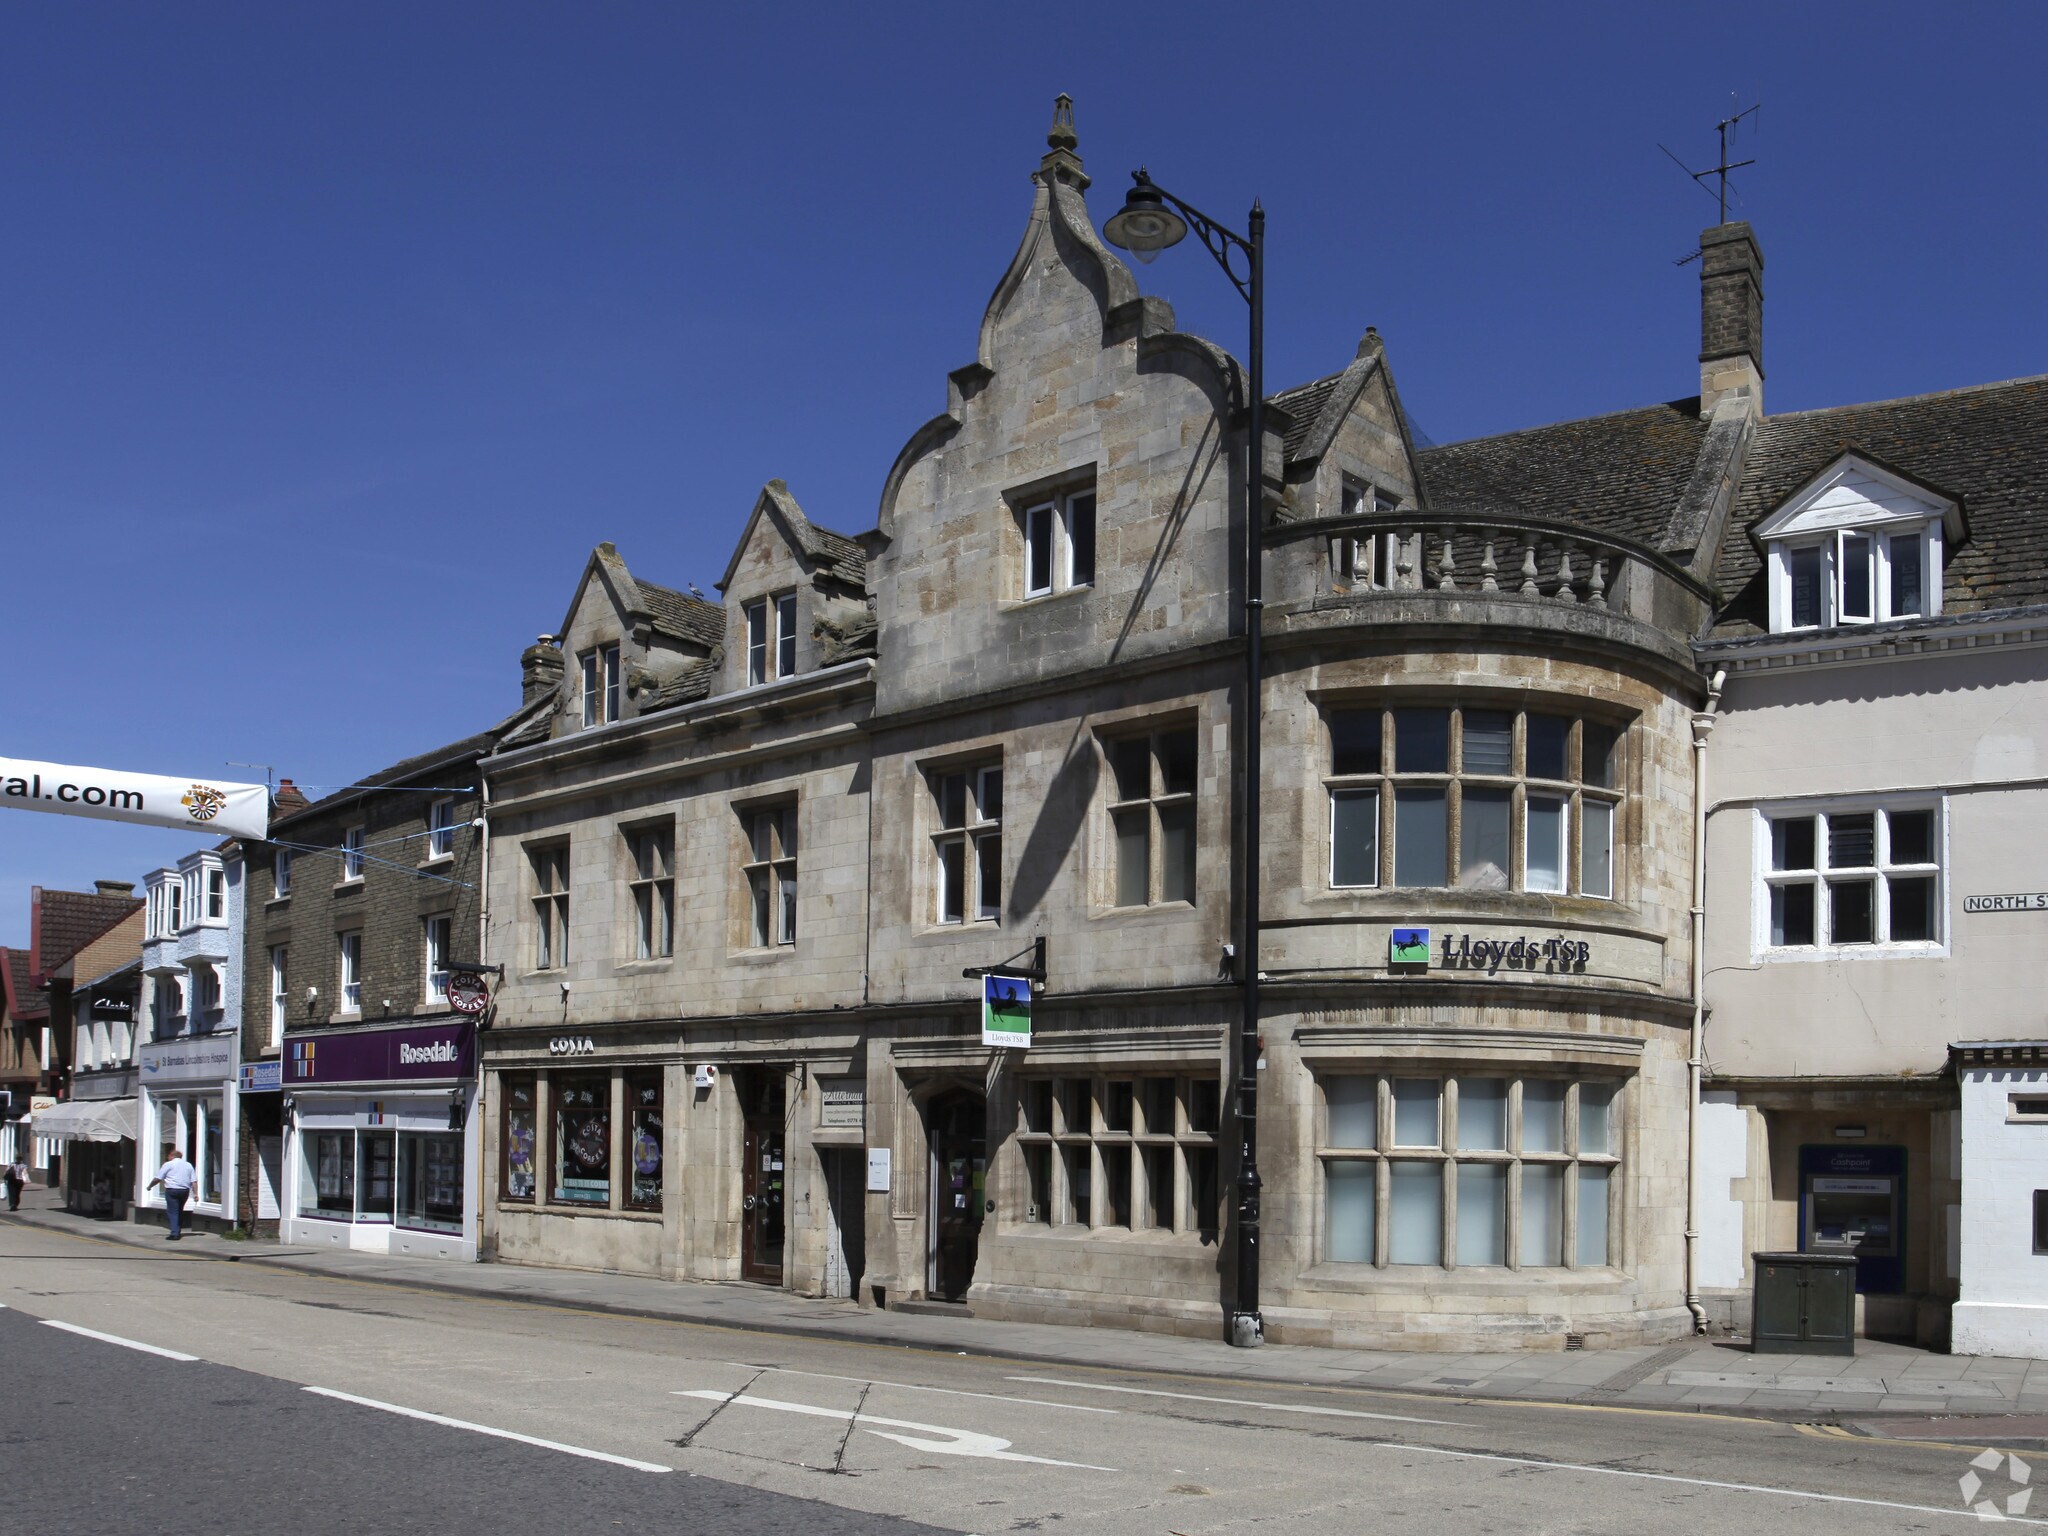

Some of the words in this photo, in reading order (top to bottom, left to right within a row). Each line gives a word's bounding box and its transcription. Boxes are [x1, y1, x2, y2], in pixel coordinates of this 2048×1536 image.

[1969, 895, 2027, 909] NORTH
[2036, 895, 2048, 907] S
[1444, 934, 1540, 965] Lloyds
[1547, 938, 1590, 962] TSB
[455, 977, 480, 988] COSTA
[453, 995, 483, 1010] COFFEE
[550, 1036, 594, 1053] COSTA
[992, 1033, 1011, 1044] Lloyds
[1013, 1035, 1024, 1043] TSB
[400, 1040, 458, 1064] Rosedale
[582, 1123, 601, 1137] COSTA
[580, 1147, 604, 1163] COFFEE
[1831, 1158, 1871, 1167] Cashpoint
